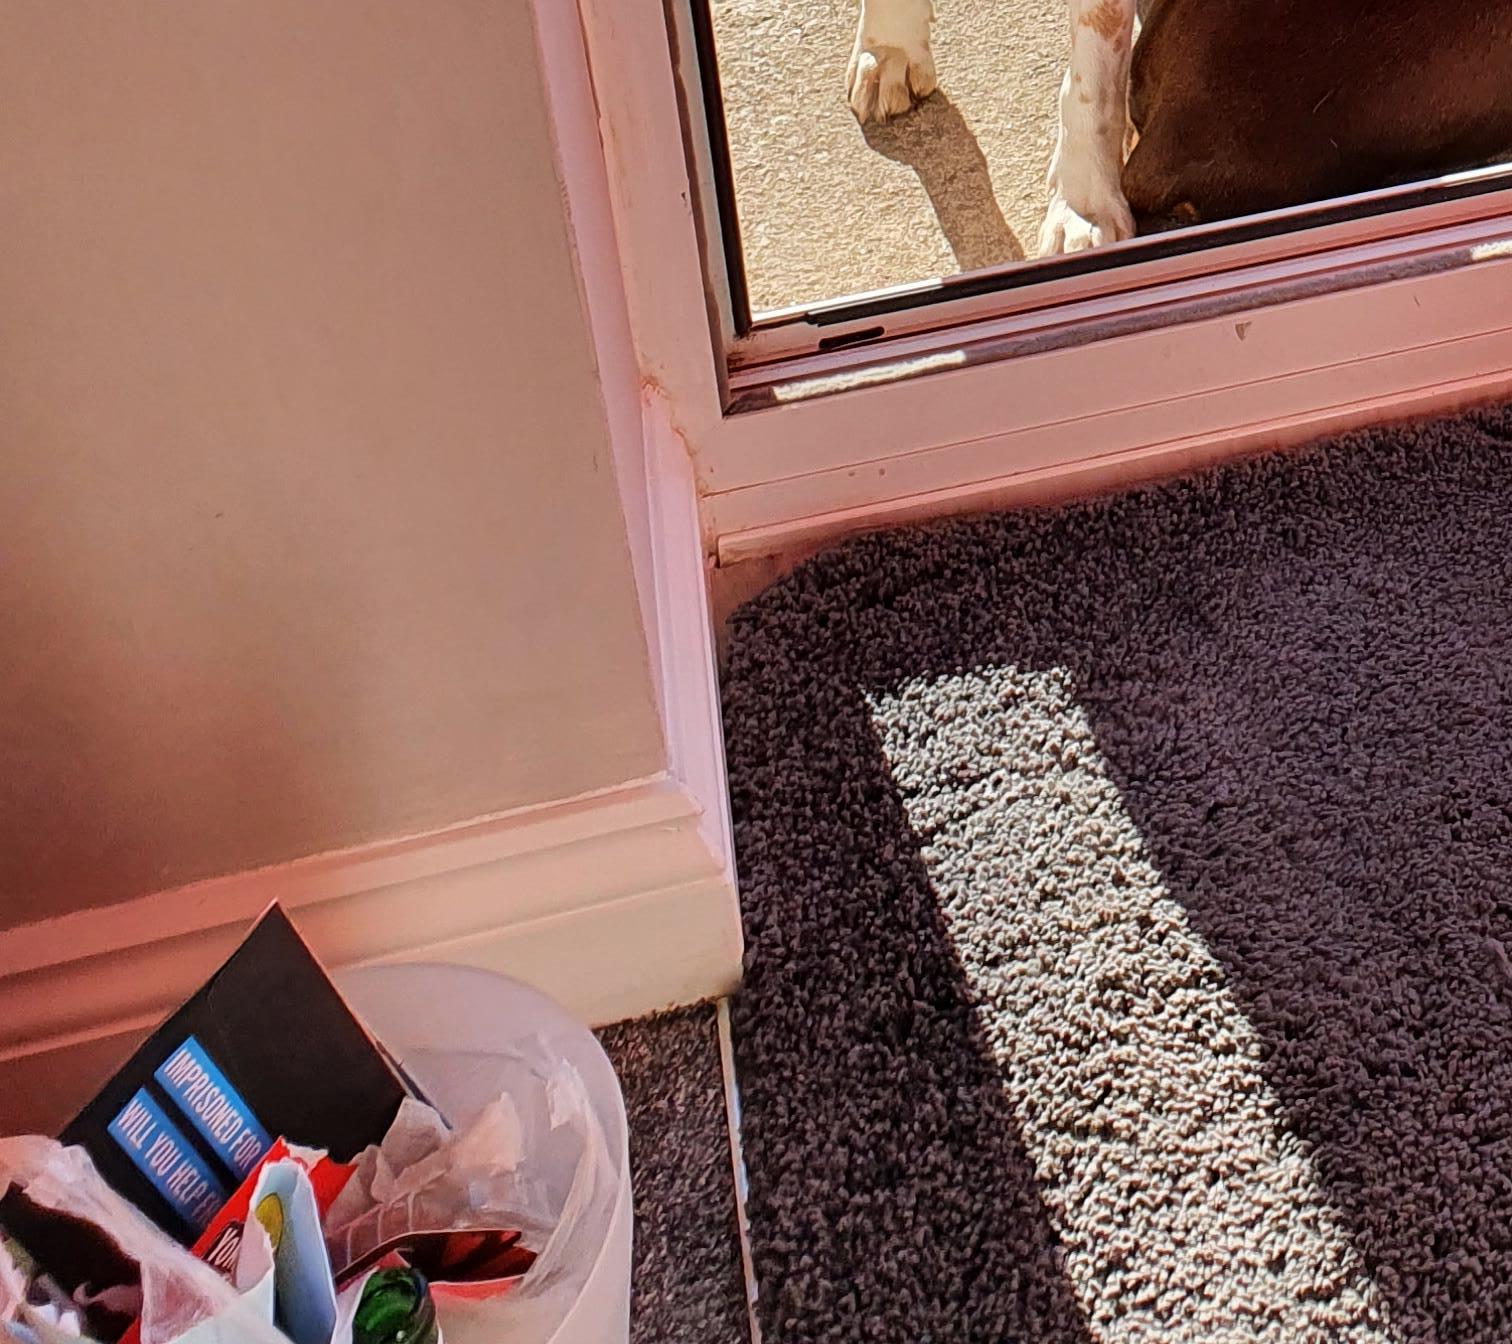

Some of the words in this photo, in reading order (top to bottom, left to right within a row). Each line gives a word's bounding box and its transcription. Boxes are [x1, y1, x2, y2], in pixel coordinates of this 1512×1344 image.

[118, 1099, 157, 1150] WILL
[144, 1132, 182, 1177] YOU
[166, 1159, 209, 1205] HELP
[164, 1048, 243, 1145] IMPRISONED
[228, 1128, 262, 1172] FOR
